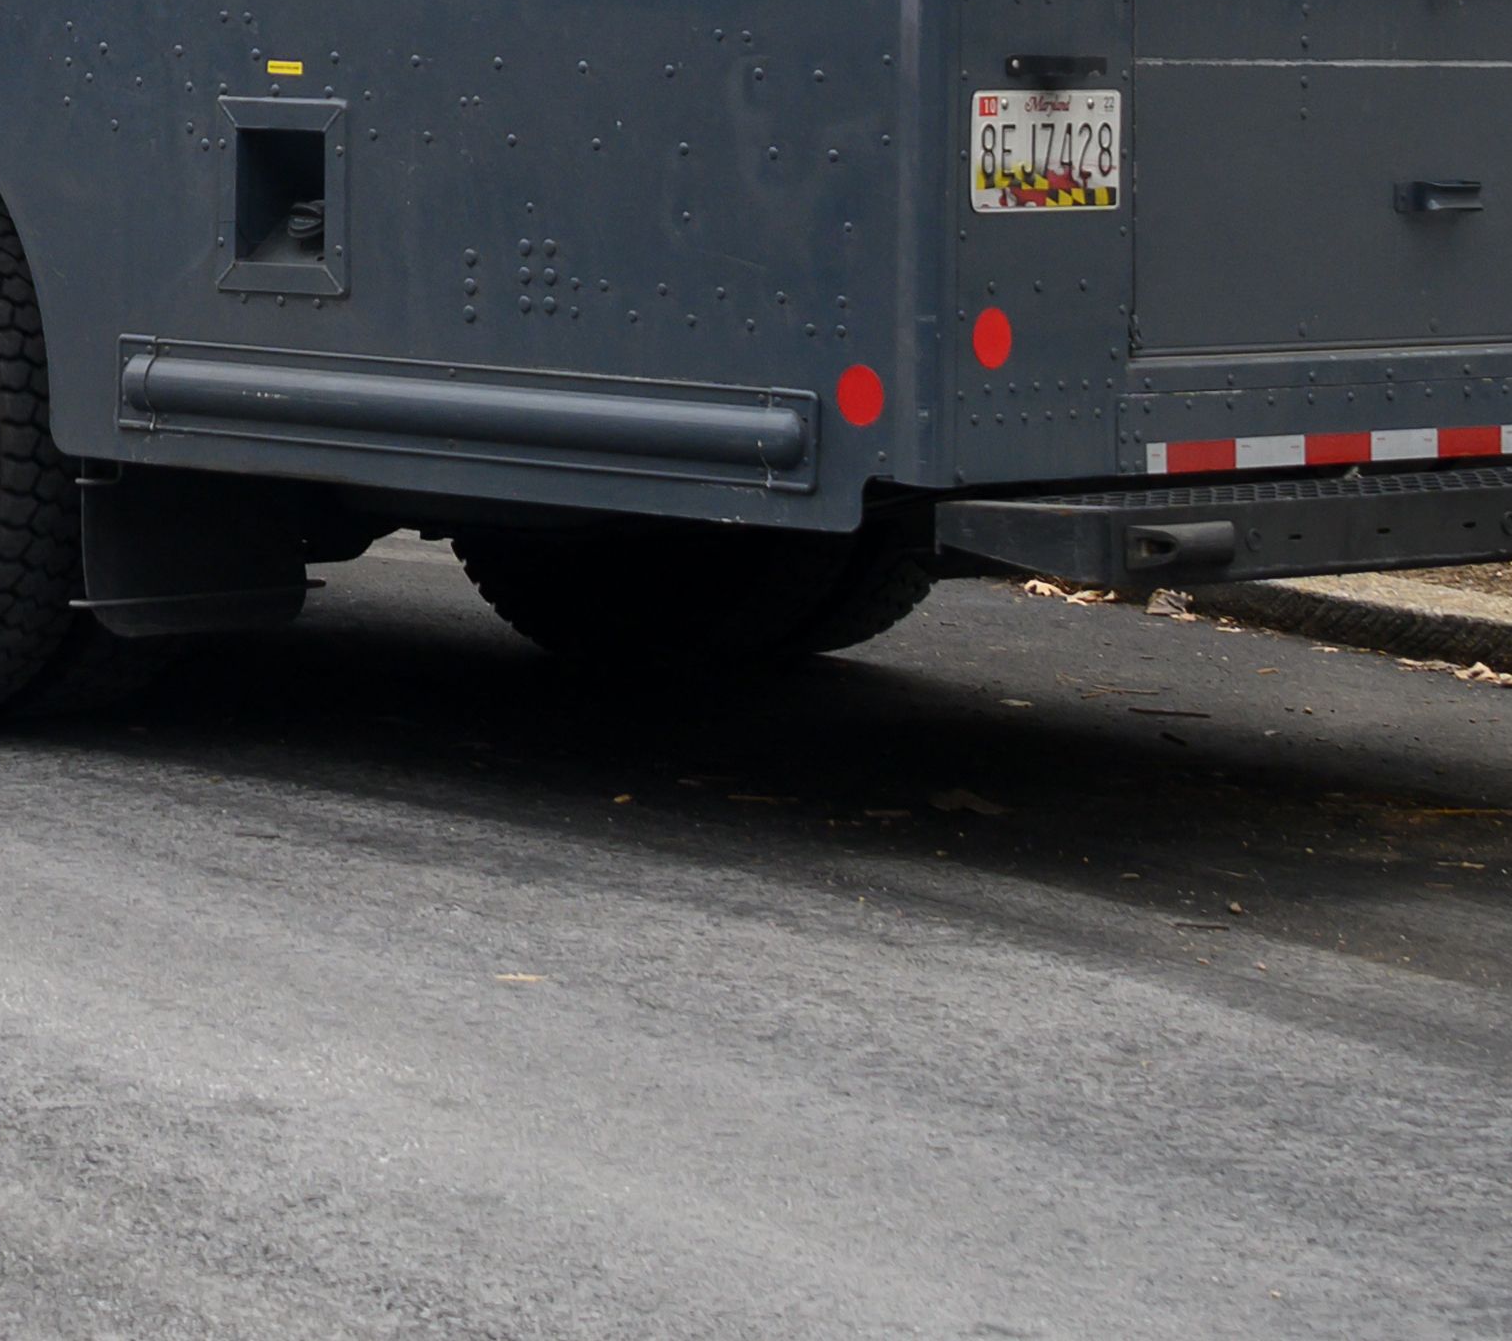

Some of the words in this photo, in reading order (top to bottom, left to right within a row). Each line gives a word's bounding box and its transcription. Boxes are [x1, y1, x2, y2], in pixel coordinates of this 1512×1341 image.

[984, 98, 996, 114] 10
[1104, 97, 1115, 109] 22
[981, 122, 1113, 180] 8EJ7428
